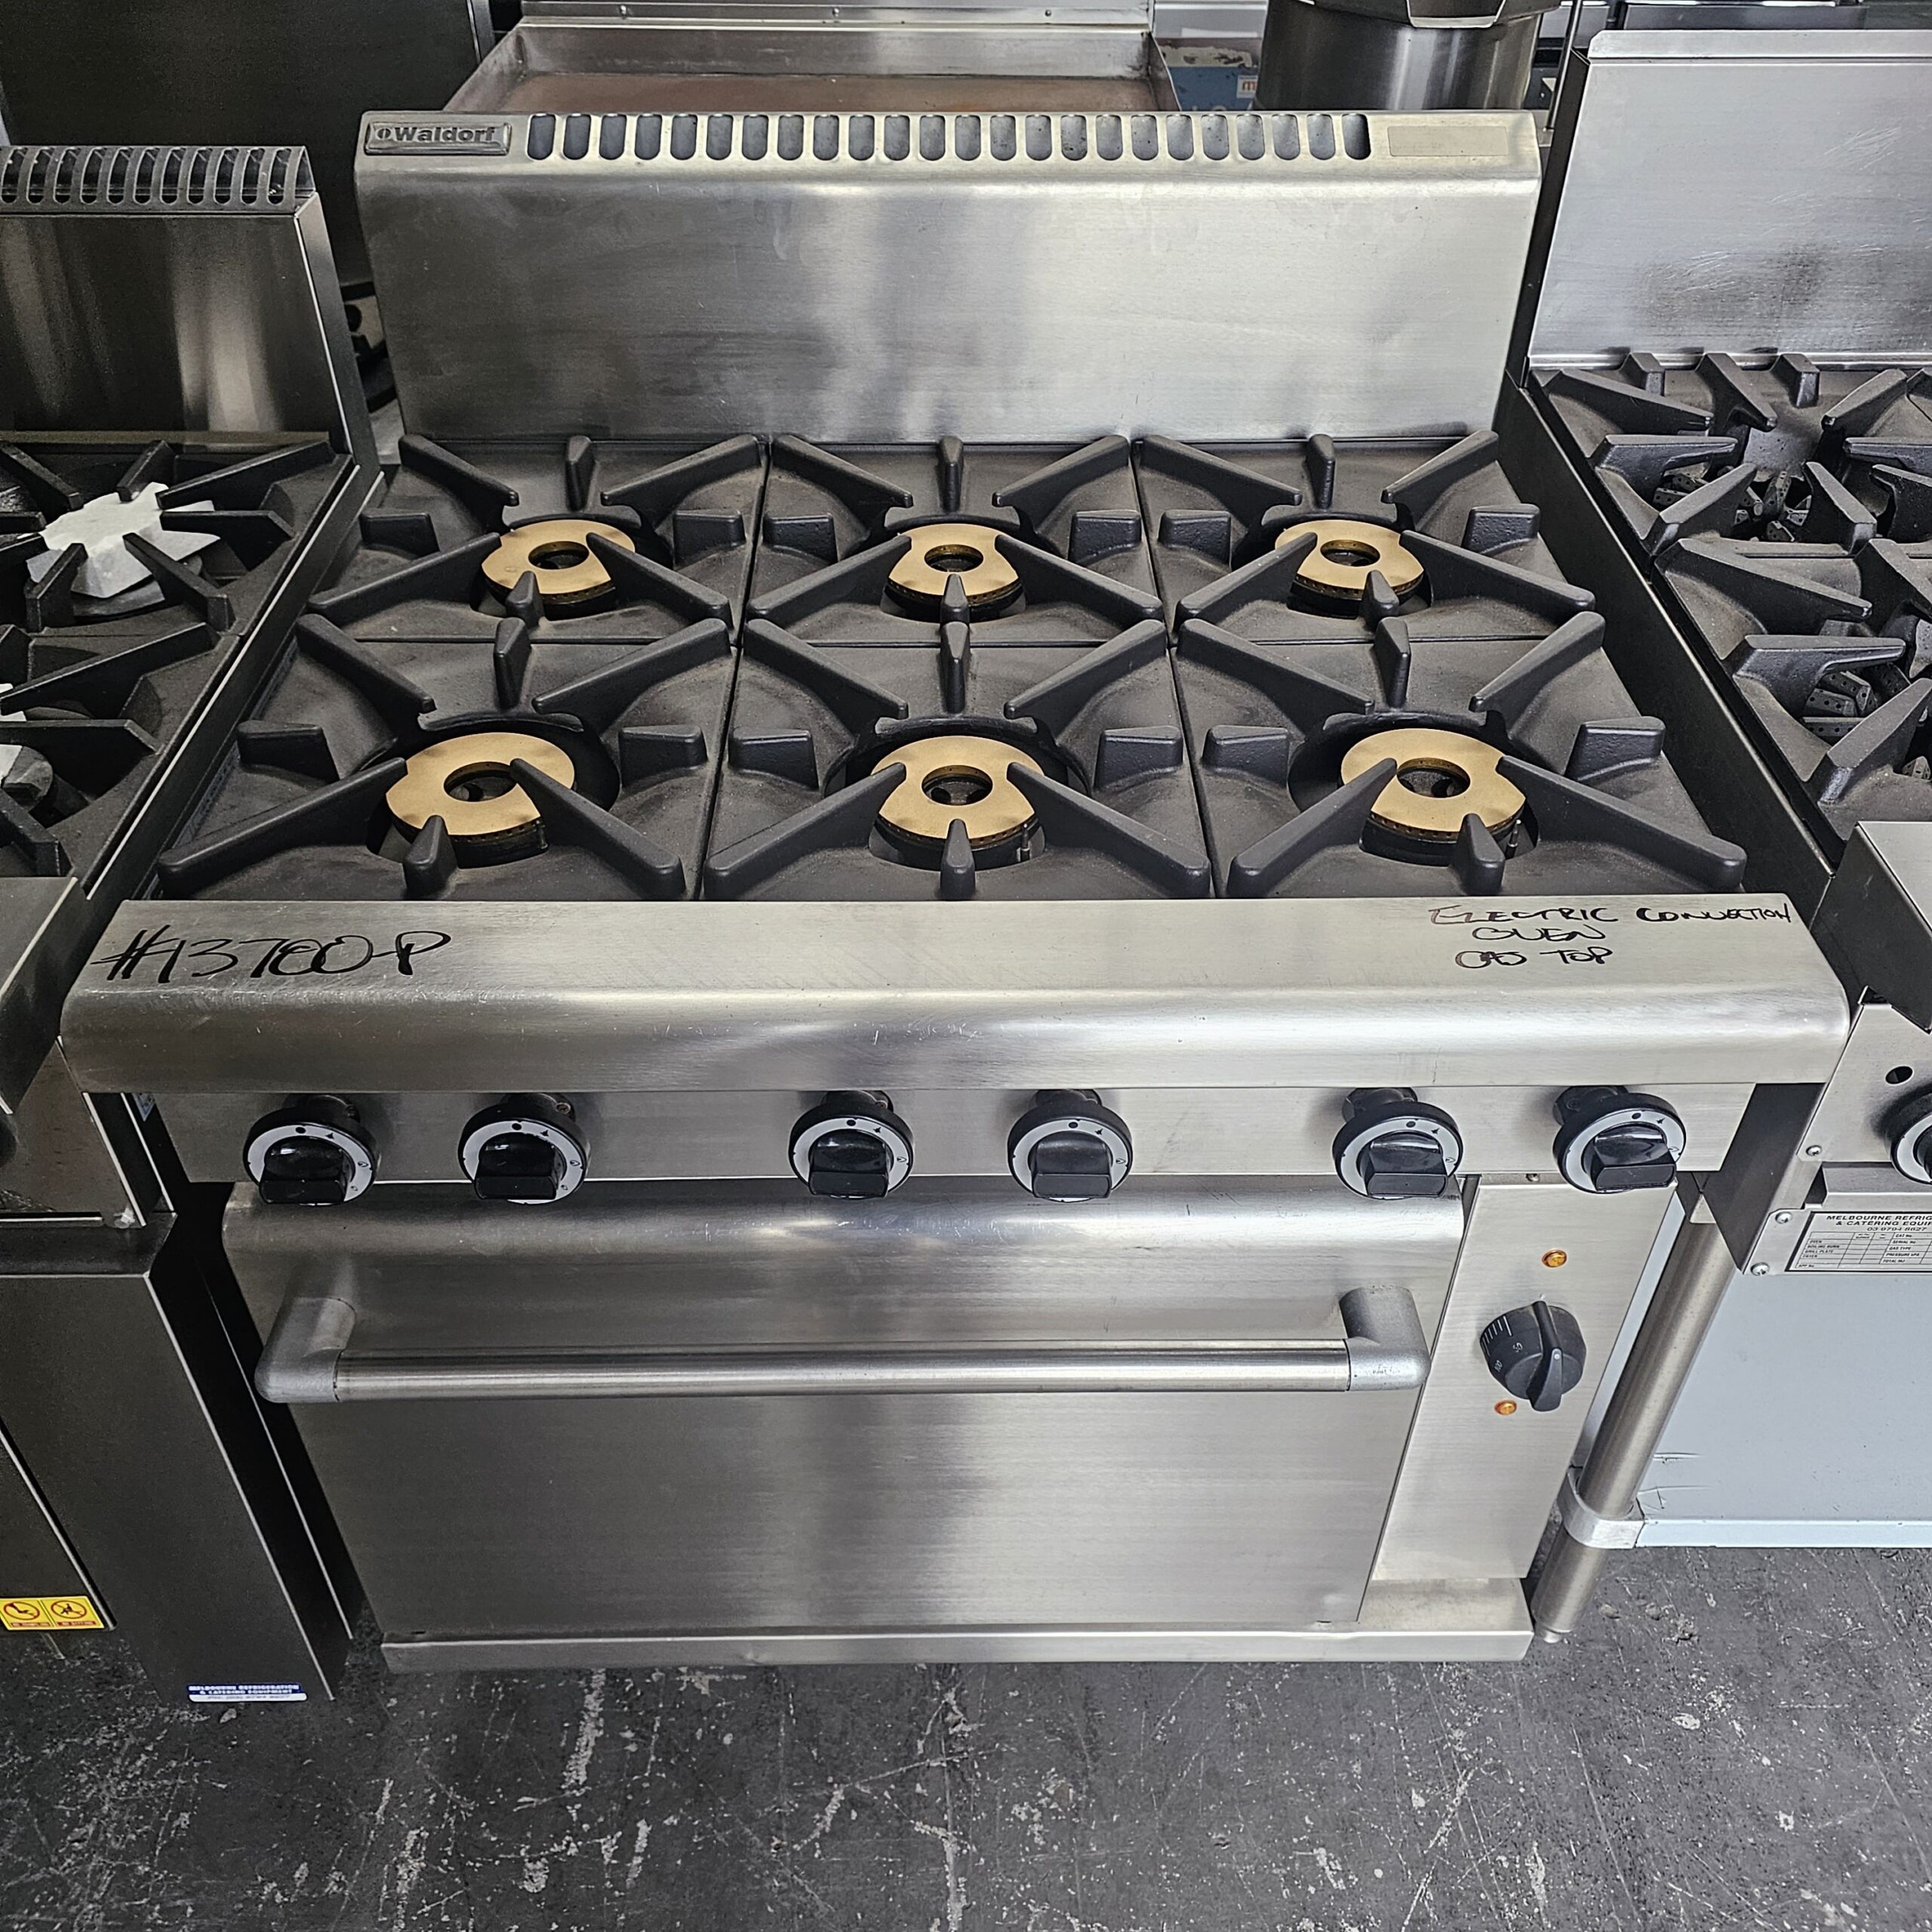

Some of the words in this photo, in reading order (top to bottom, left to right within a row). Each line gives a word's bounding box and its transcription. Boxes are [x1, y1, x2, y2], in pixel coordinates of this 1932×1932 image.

[395, 127, 494, 141] Waldorf
[1429, 905, 1619, 924] ELECTRIC
[1540, 947, 1613, 964] TOP
